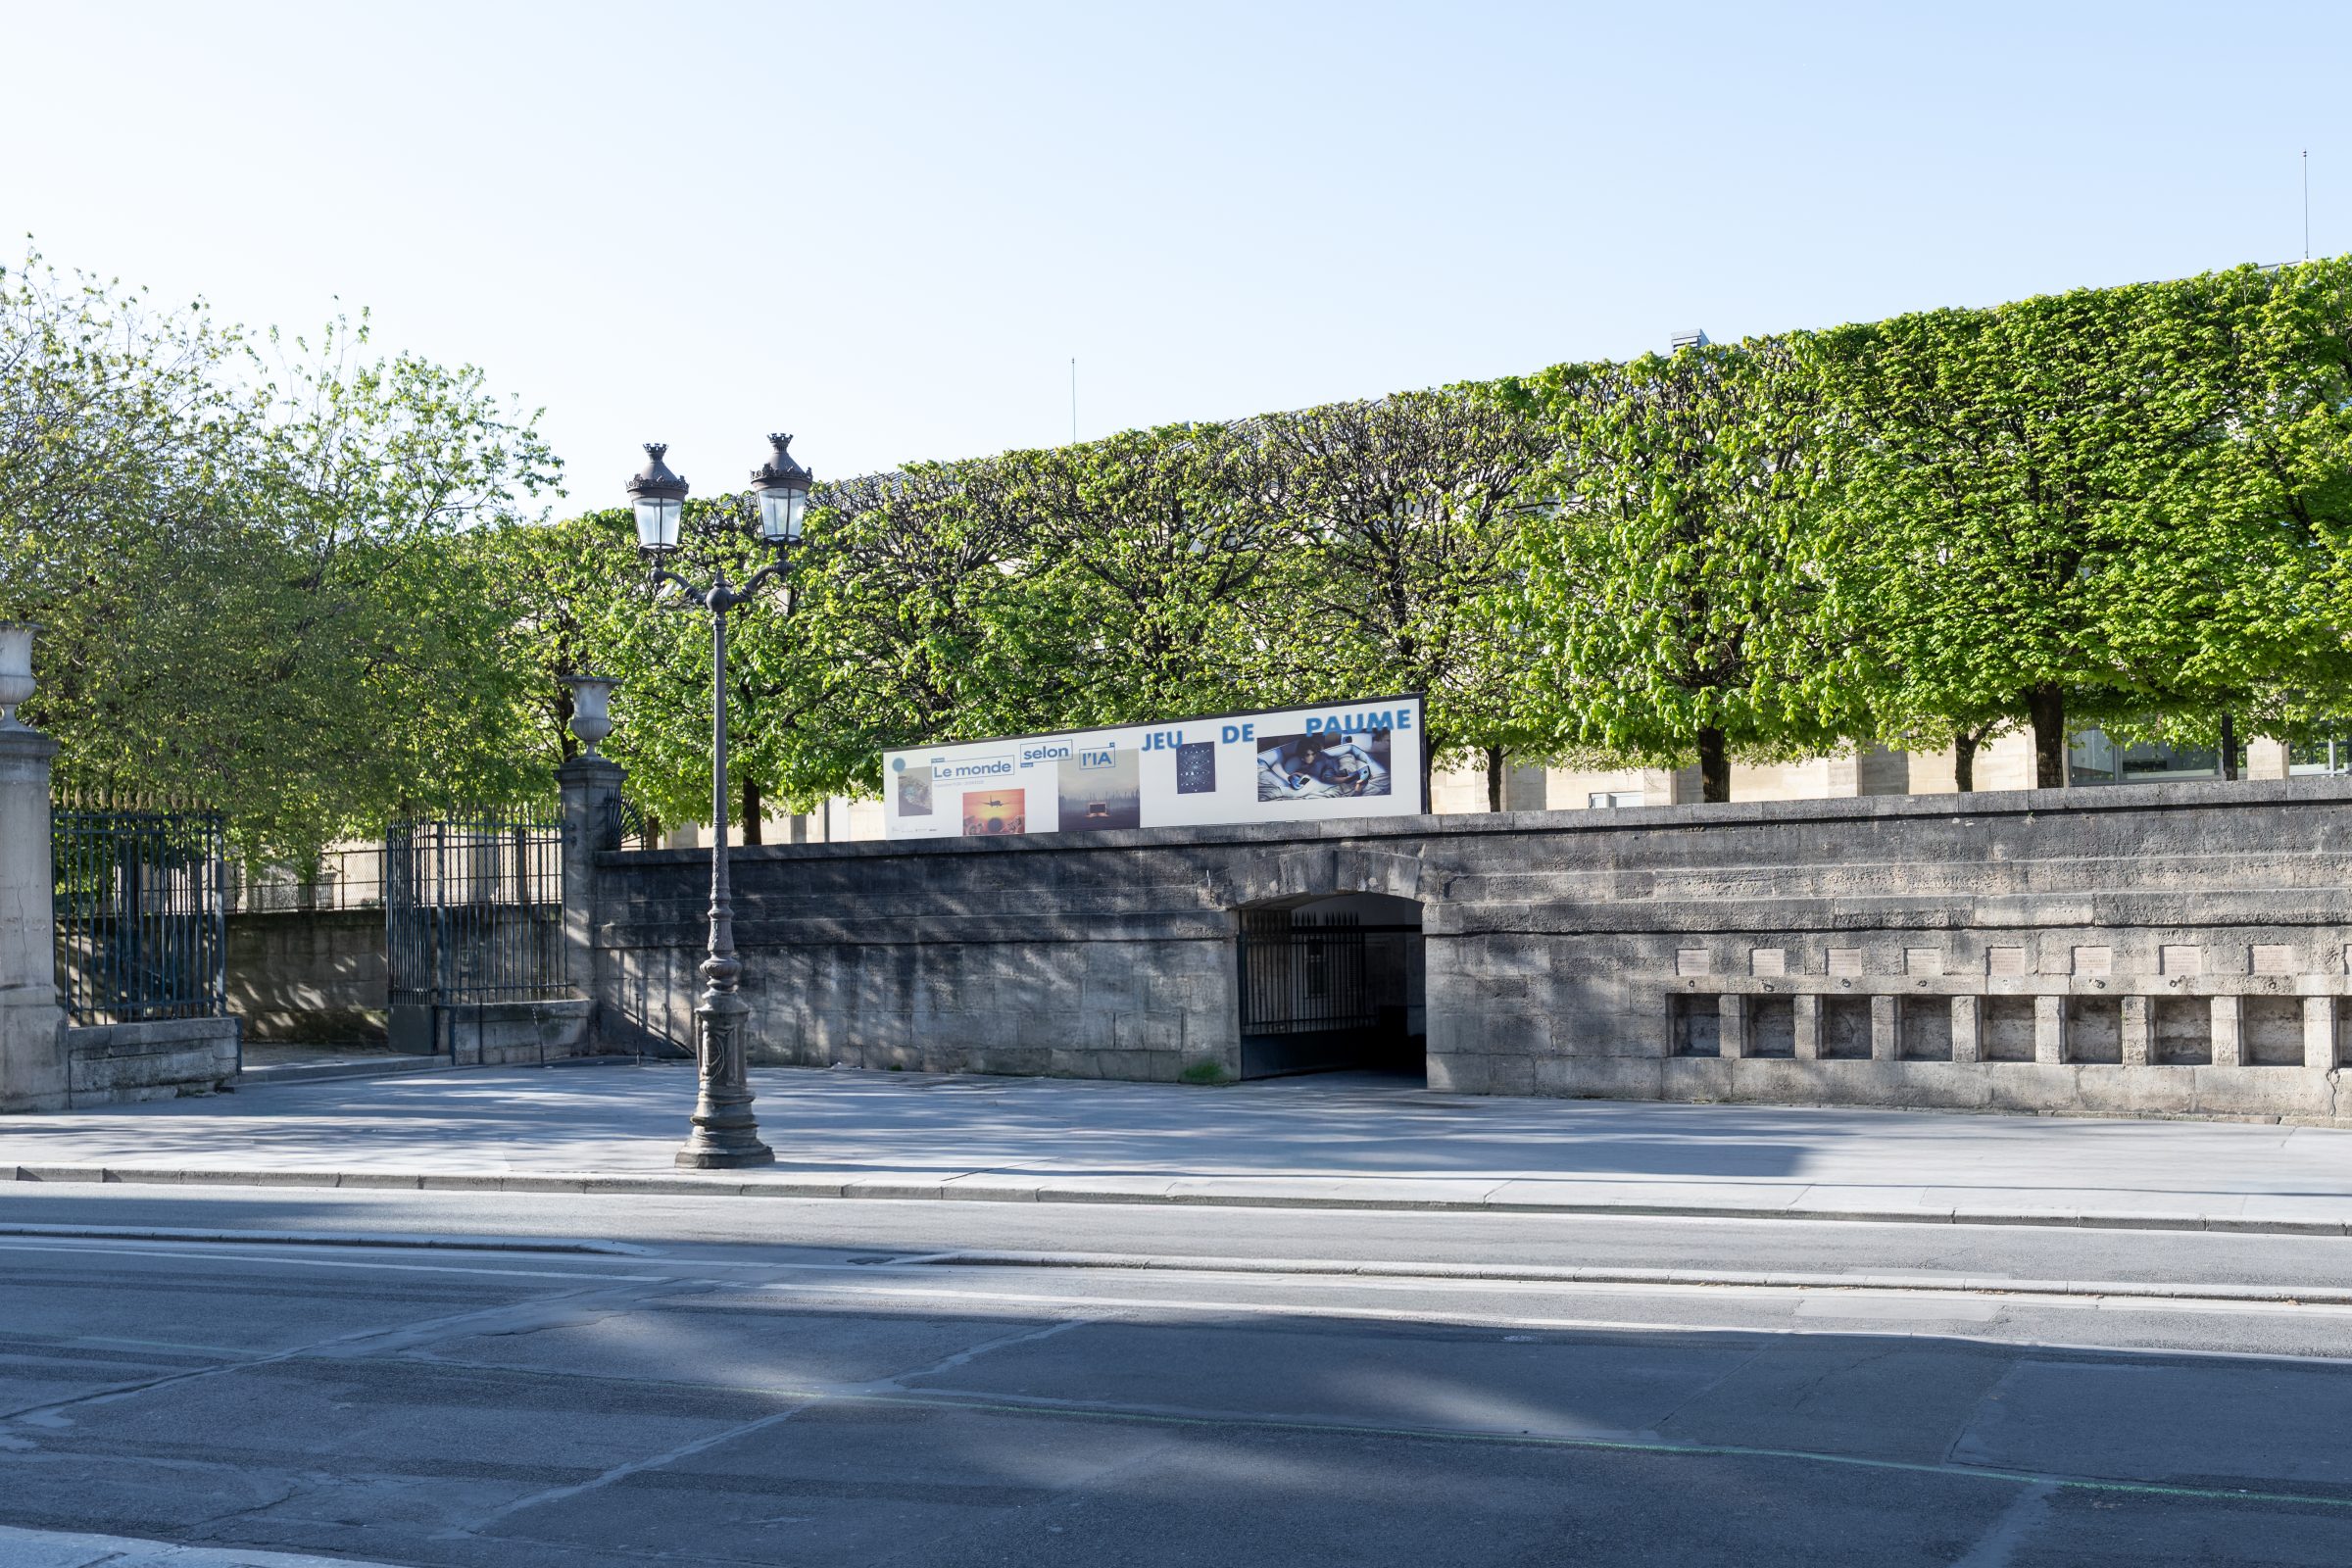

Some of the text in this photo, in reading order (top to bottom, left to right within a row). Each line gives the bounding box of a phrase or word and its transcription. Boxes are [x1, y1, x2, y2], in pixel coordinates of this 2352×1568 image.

[1142, 709, 1412, 752] JEU DE PAUME
[934, 767, 953, 778] Le
[956, 761, 1011, 776] monde
[1024, 744, 1069, 760] selon
